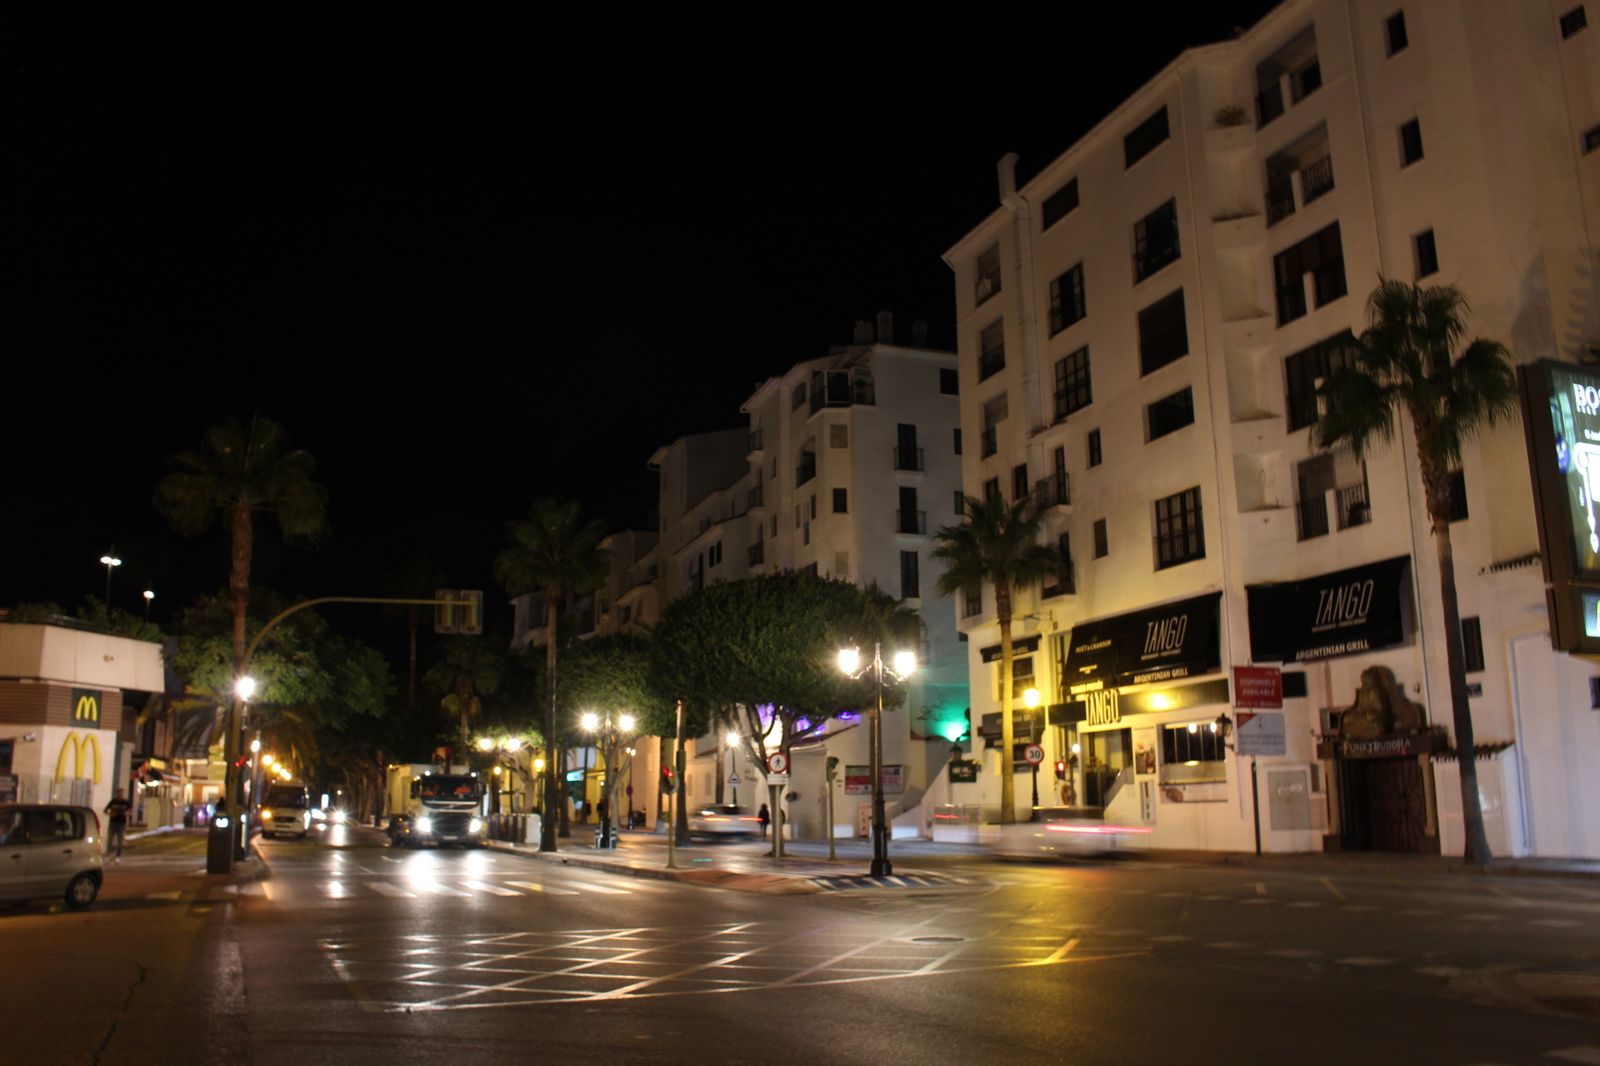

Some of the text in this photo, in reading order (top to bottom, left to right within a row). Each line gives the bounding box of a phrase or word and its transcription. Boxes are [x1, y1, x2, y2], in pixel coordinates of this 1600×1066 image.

[1315, 579, 1374, 625] TANGO
[1144, 614, 1188, 654] TANGO
[1295, 639, 1369, 660] ARGENTINIAN GRILL
[1134, 666, 1188, 684] ARGENTINIAN GRILL
[1241, 687, 1276, 696] AVAILABLE
[1085, 688, 1120, 726] TANGO
[1028, 750, 1041, 759] 30
